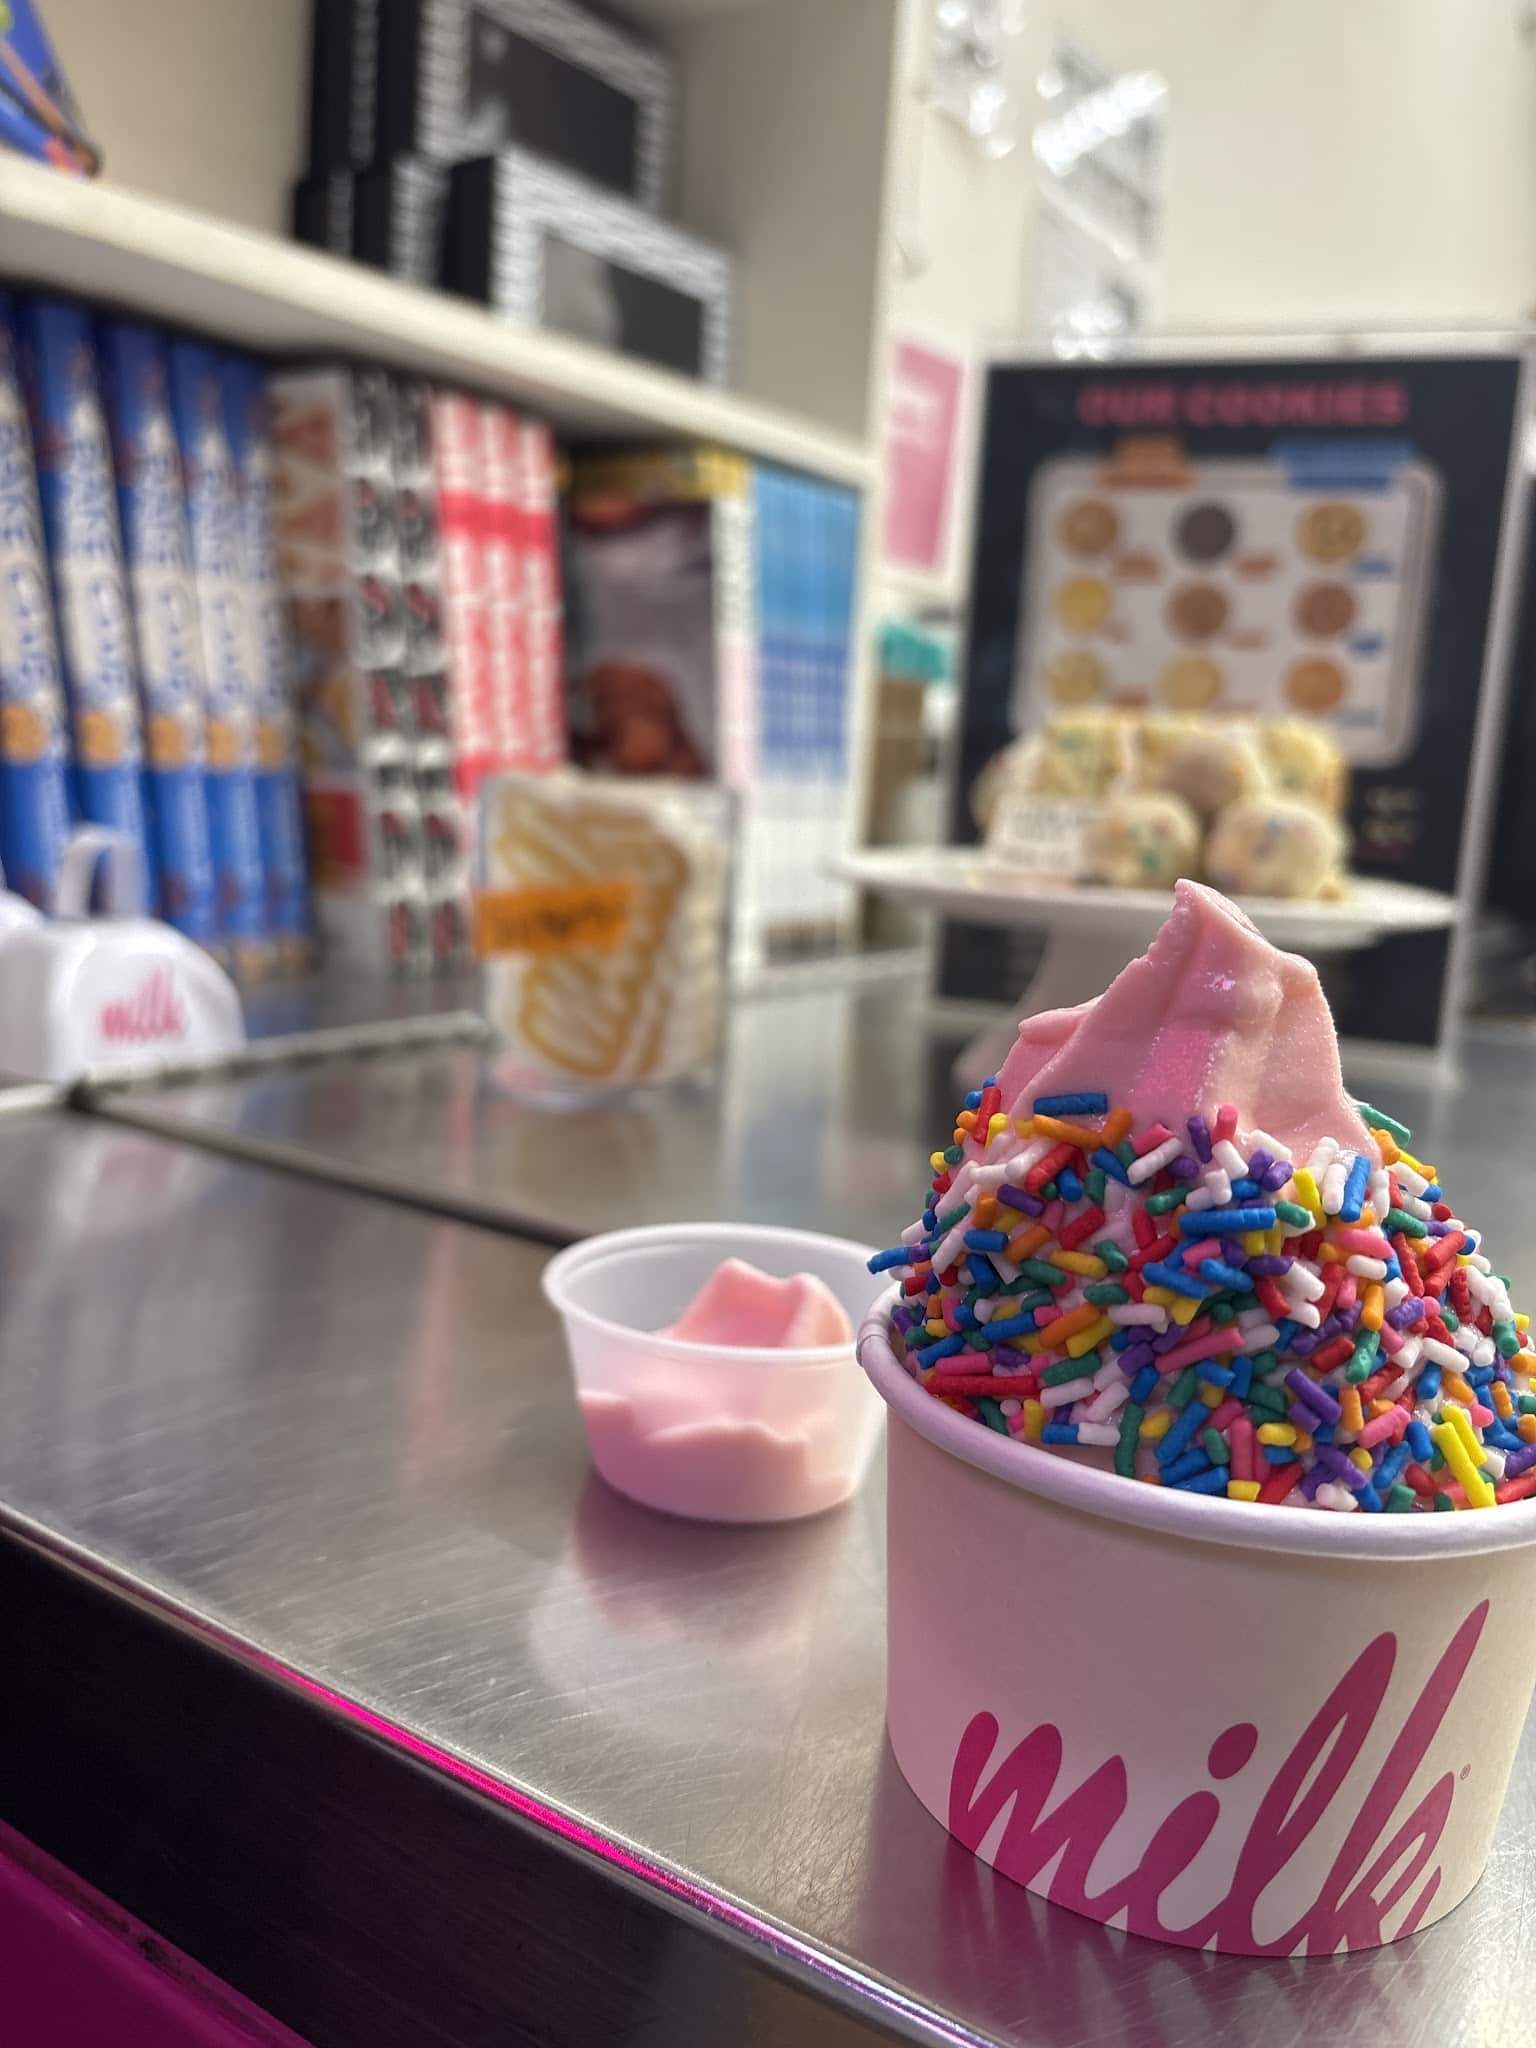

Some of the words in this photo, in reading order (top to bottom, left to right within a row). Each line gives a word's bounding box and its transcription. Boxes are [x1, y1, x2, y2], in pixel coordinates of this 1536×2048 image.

[1185, 383, 1406, 423] COOKIES
[99, 968, 186, 1043] milk
[949, 1599, 1489, 1957] milk
